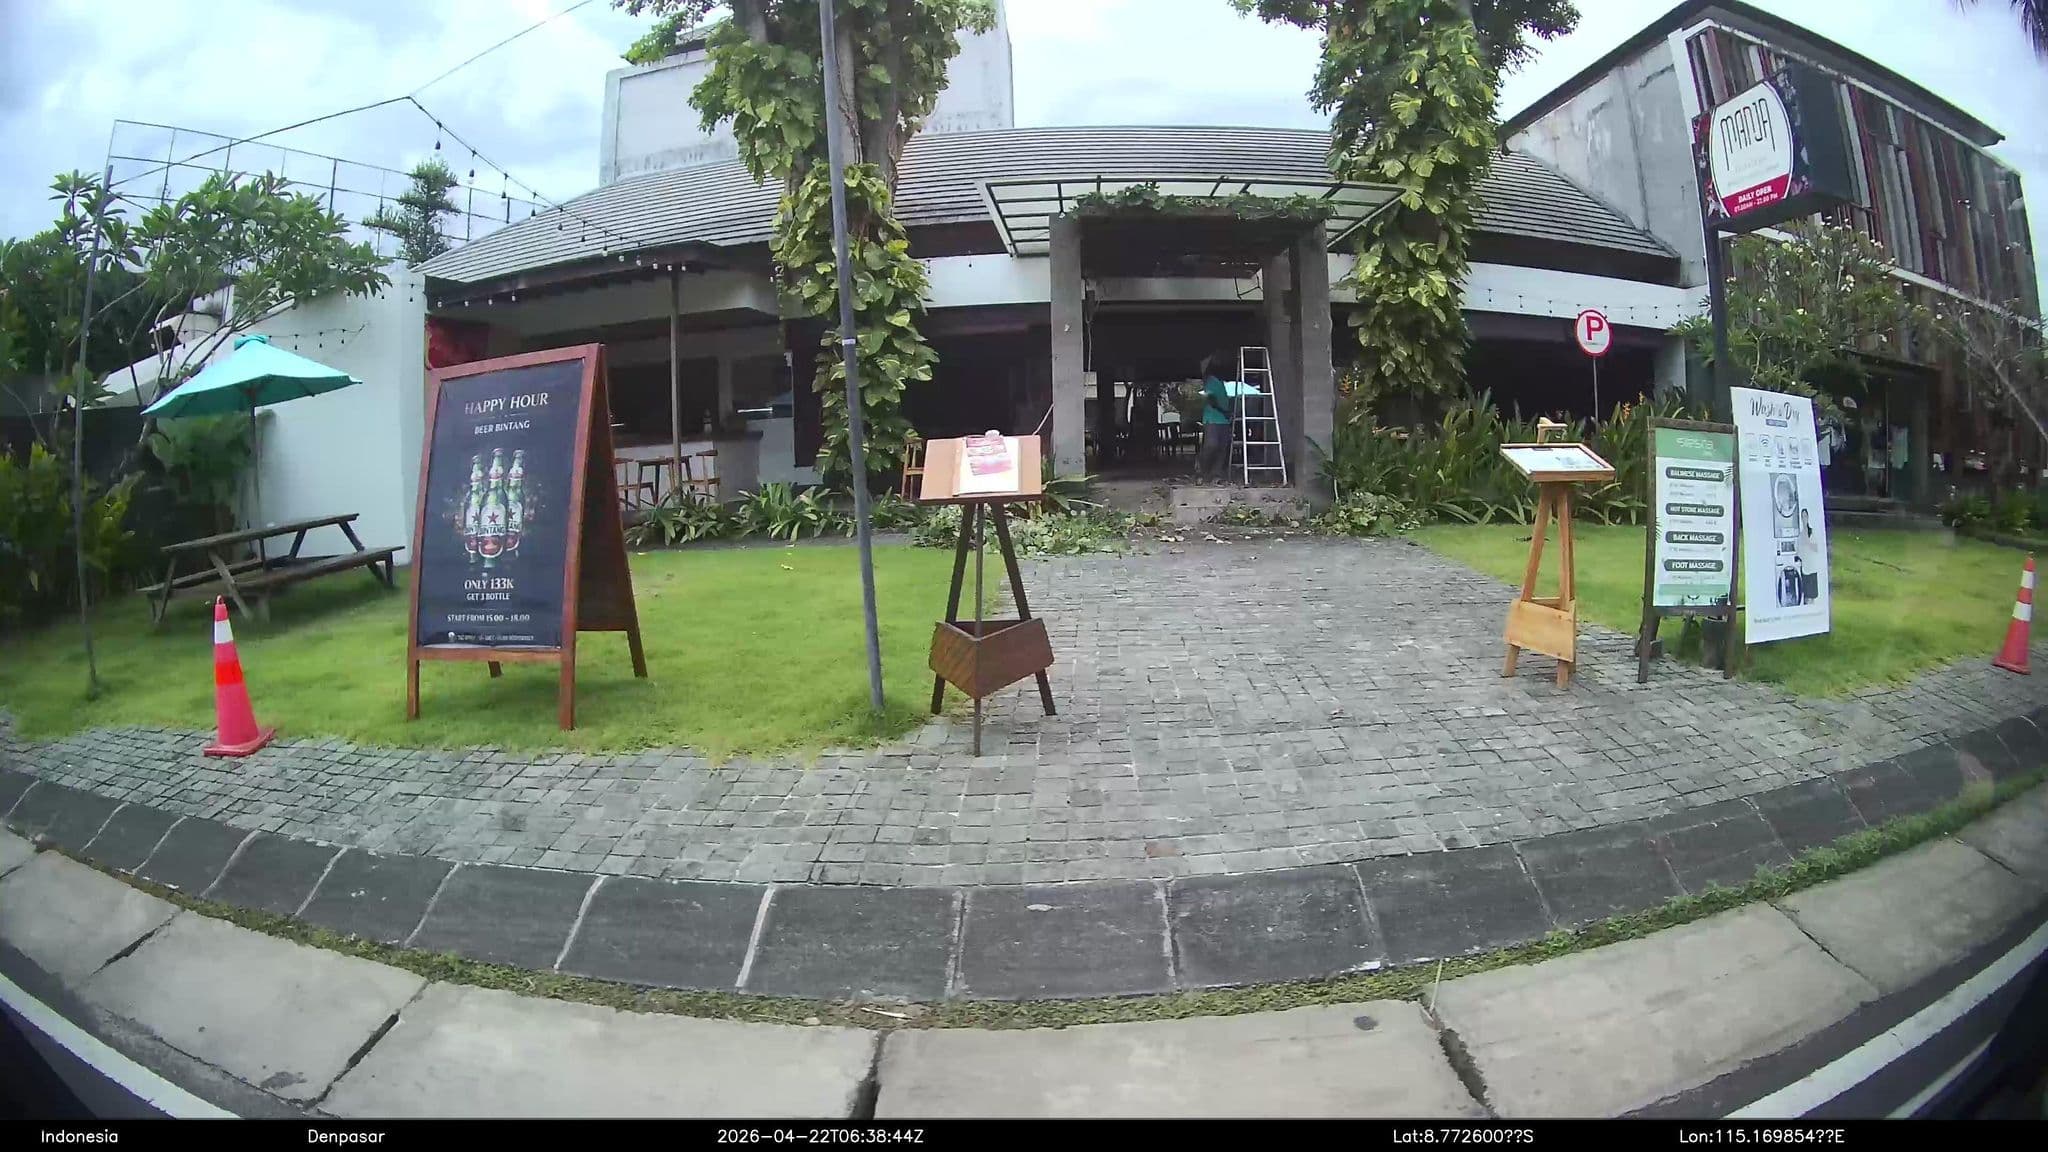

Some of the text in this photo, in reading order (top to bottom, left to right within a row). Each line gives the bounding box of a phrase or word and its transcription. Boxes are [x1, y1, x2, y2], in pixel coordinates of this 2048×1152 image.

[1720, 98, 1776, 171] MANJA
[1738, 185, 1772, 203] DAILY OPEN
[1586, 315, 1604, 341] P
[464, 392, 549, 415] HAPPY HOUR
[1749, 396, 1775, 418] Wash
[474, 420, 530, 435] BEER BINTANG
[1695, 471, 1721, 479] MASSAGE
[1697, 507, 1720, 515] MASSAGE
[1672, 533, 1717, 542] BACK MASSAGE
[1671, 561, 1688, 569] FOOT
[464, 577, 514, 590] ONLY 133K
[466, 592, 480, 601] GET
[485, 592, 510, 601] BOTTLE
[447, 614, 466, 622] START
[466, 614, 485, 622] FROM
